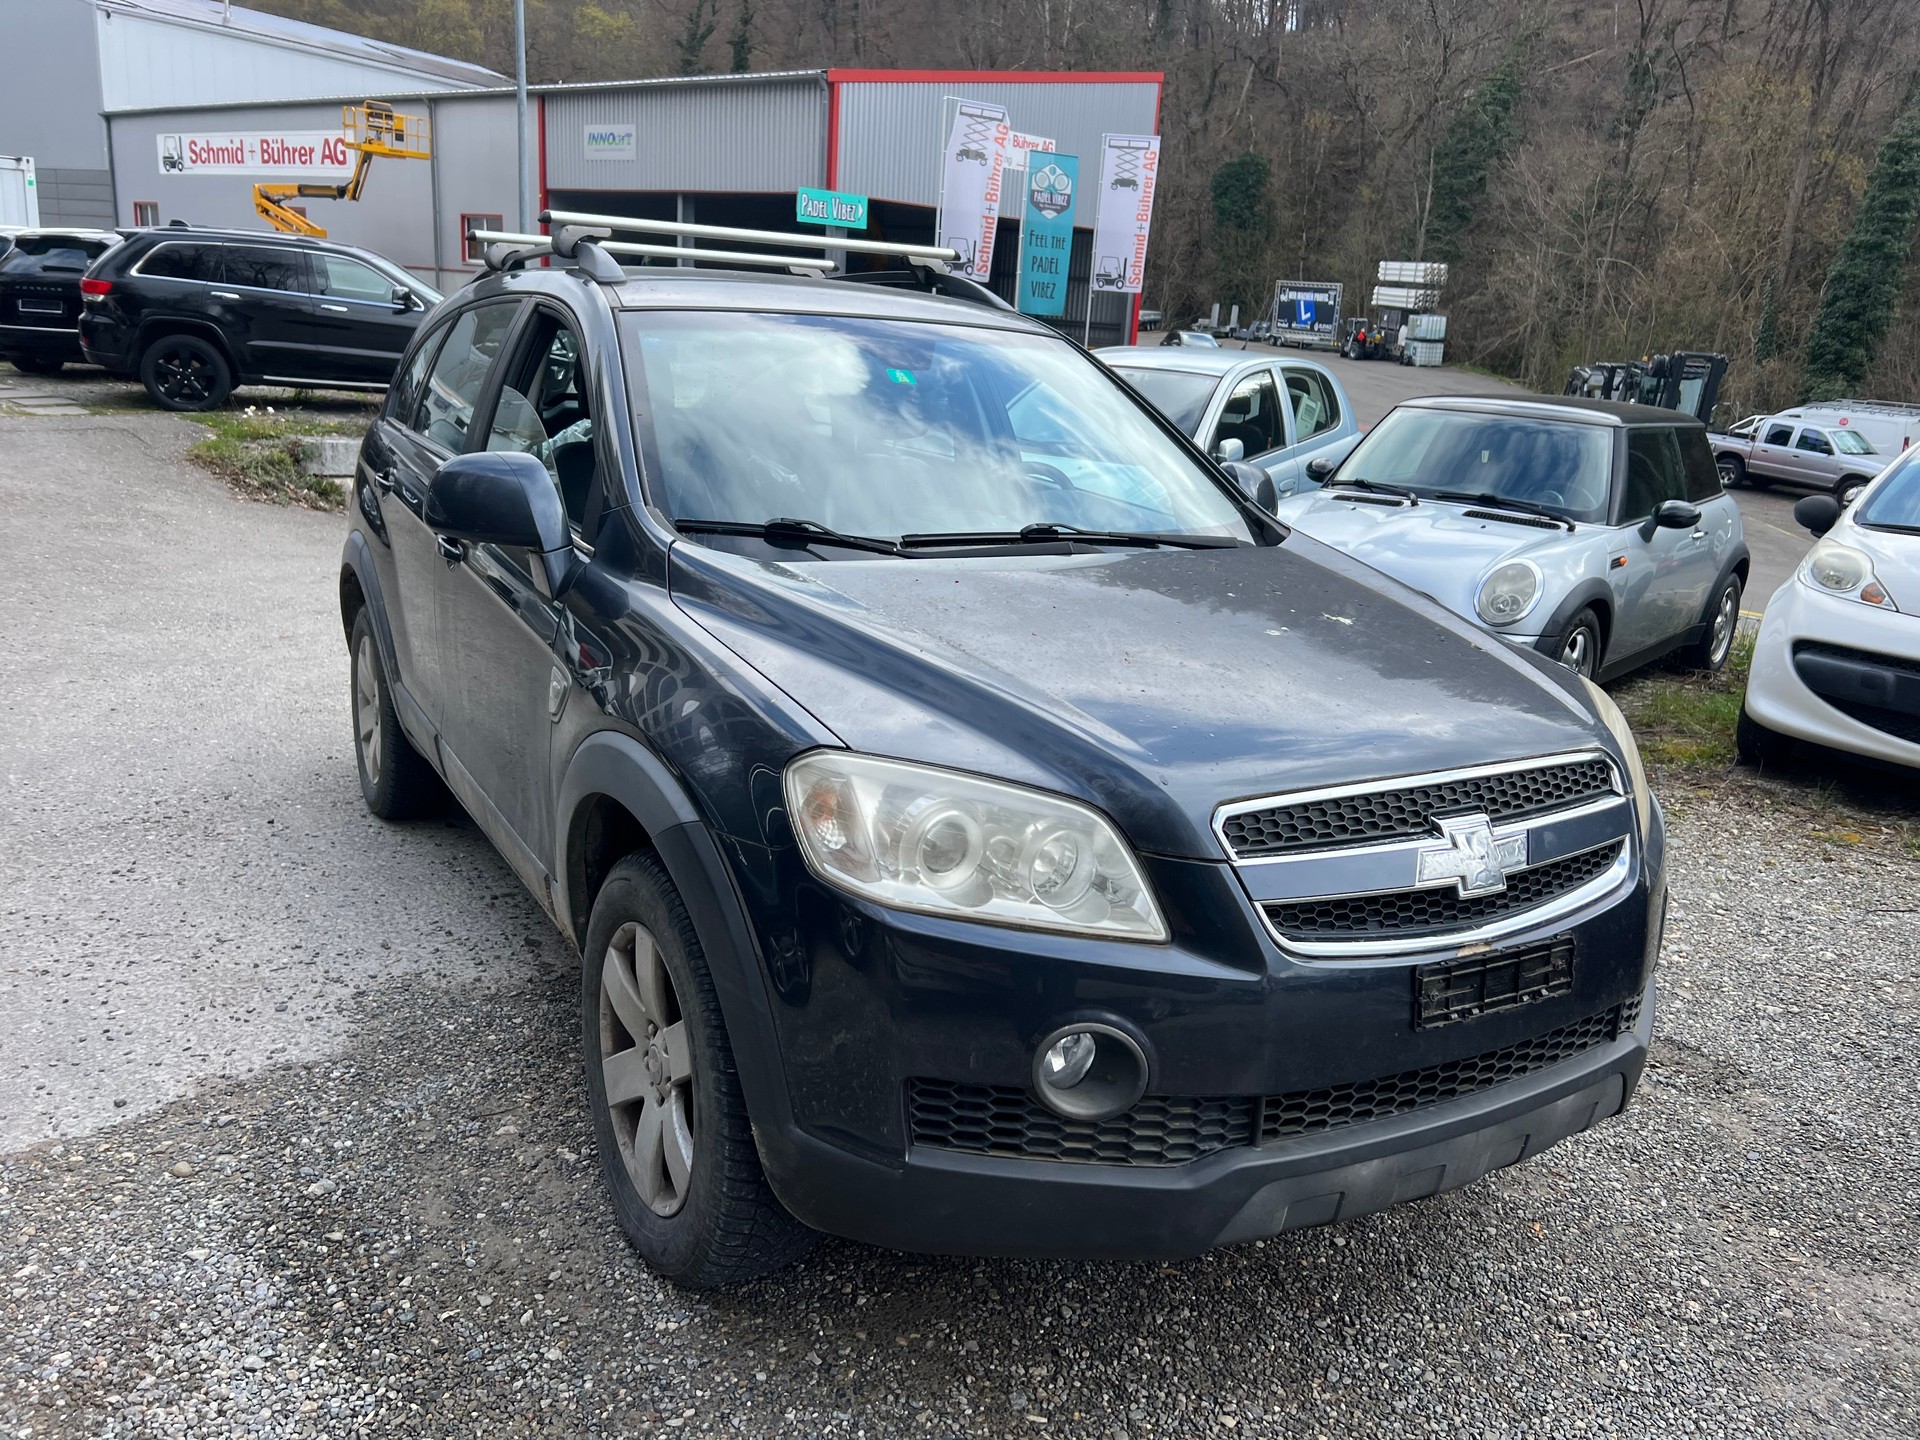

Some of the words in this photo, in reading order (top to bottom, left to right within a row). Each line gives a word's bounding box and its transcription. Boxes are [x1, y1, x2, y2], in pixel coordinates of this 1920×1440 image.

[994, 122, 1009, 149] AG
[1012, 134, 1040, 150] Bührer
[1042, 140, 1054, 152] AG
[189, 139, 245, 165] Schmid
[260, 138, 315, 165] Bührer
[321, 137, 347, 166] AG
[1143, 150, 1157, 172] AG
[984, 149, 1004, 203] Bührer
[1033, 191, 1051, 204] PADEL
[1052, 193, 1068, 206] VIBEZ
[1136, 174, 1154, 223] Bührer
[976, 214, 996, 274] Schmid
[1029, 229, 1048, 249] FEEL
[1051, 235, 1066, 250] THE
[1031, 255, 1060, 275] PADEL
[1128, 233, 1146, 286] Schmid
[1031, 280, 1057, 300] VIBEZ
[1300, 300, 1311, 320] L
